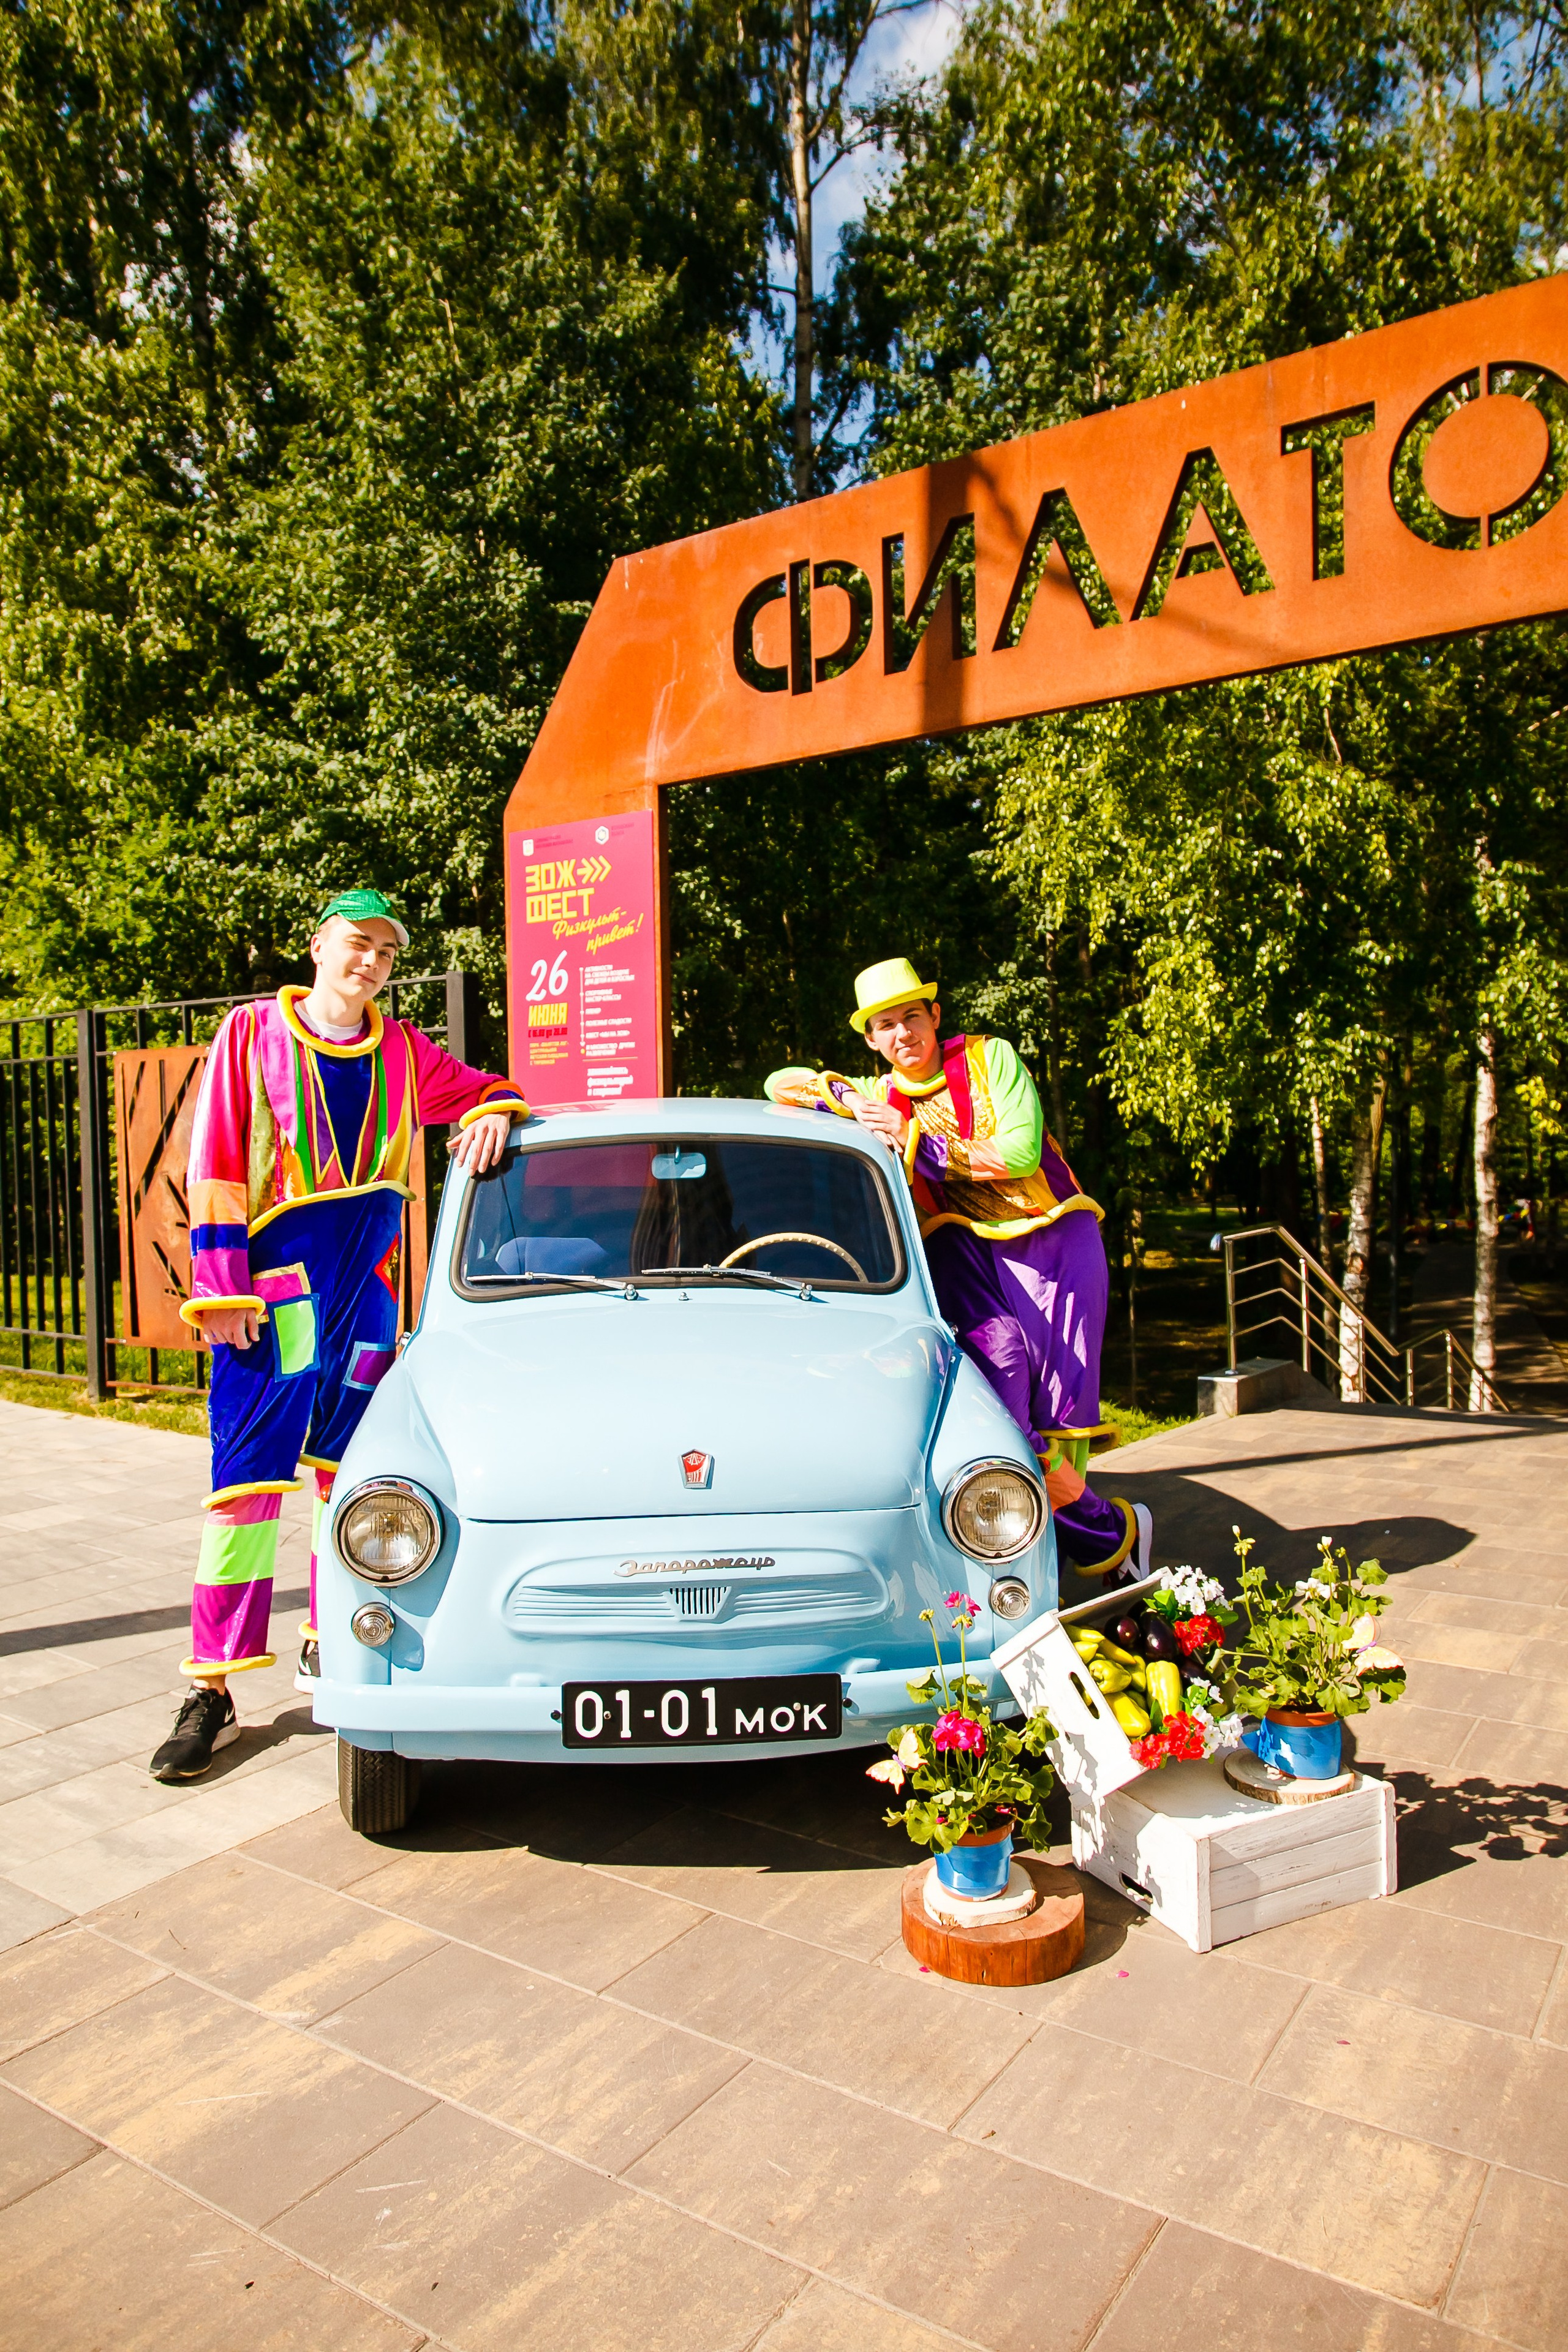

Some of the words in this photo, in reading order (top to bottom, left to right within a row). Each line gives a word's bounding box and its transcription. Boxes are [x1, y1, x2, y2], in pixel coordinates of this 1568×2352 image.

[526, 859, 576, 893] ЗОЖ
[526, 888, 595, 924] ФЕСТ
[586, 913, 644, 956] привет!
[526, 949, 569, 1001] 26
[527, 1001, 568, 1027] ИЮНЯ
[575, 1687, 718, 1738] 01-01
[735, 1703, 827, 1736] МОК
